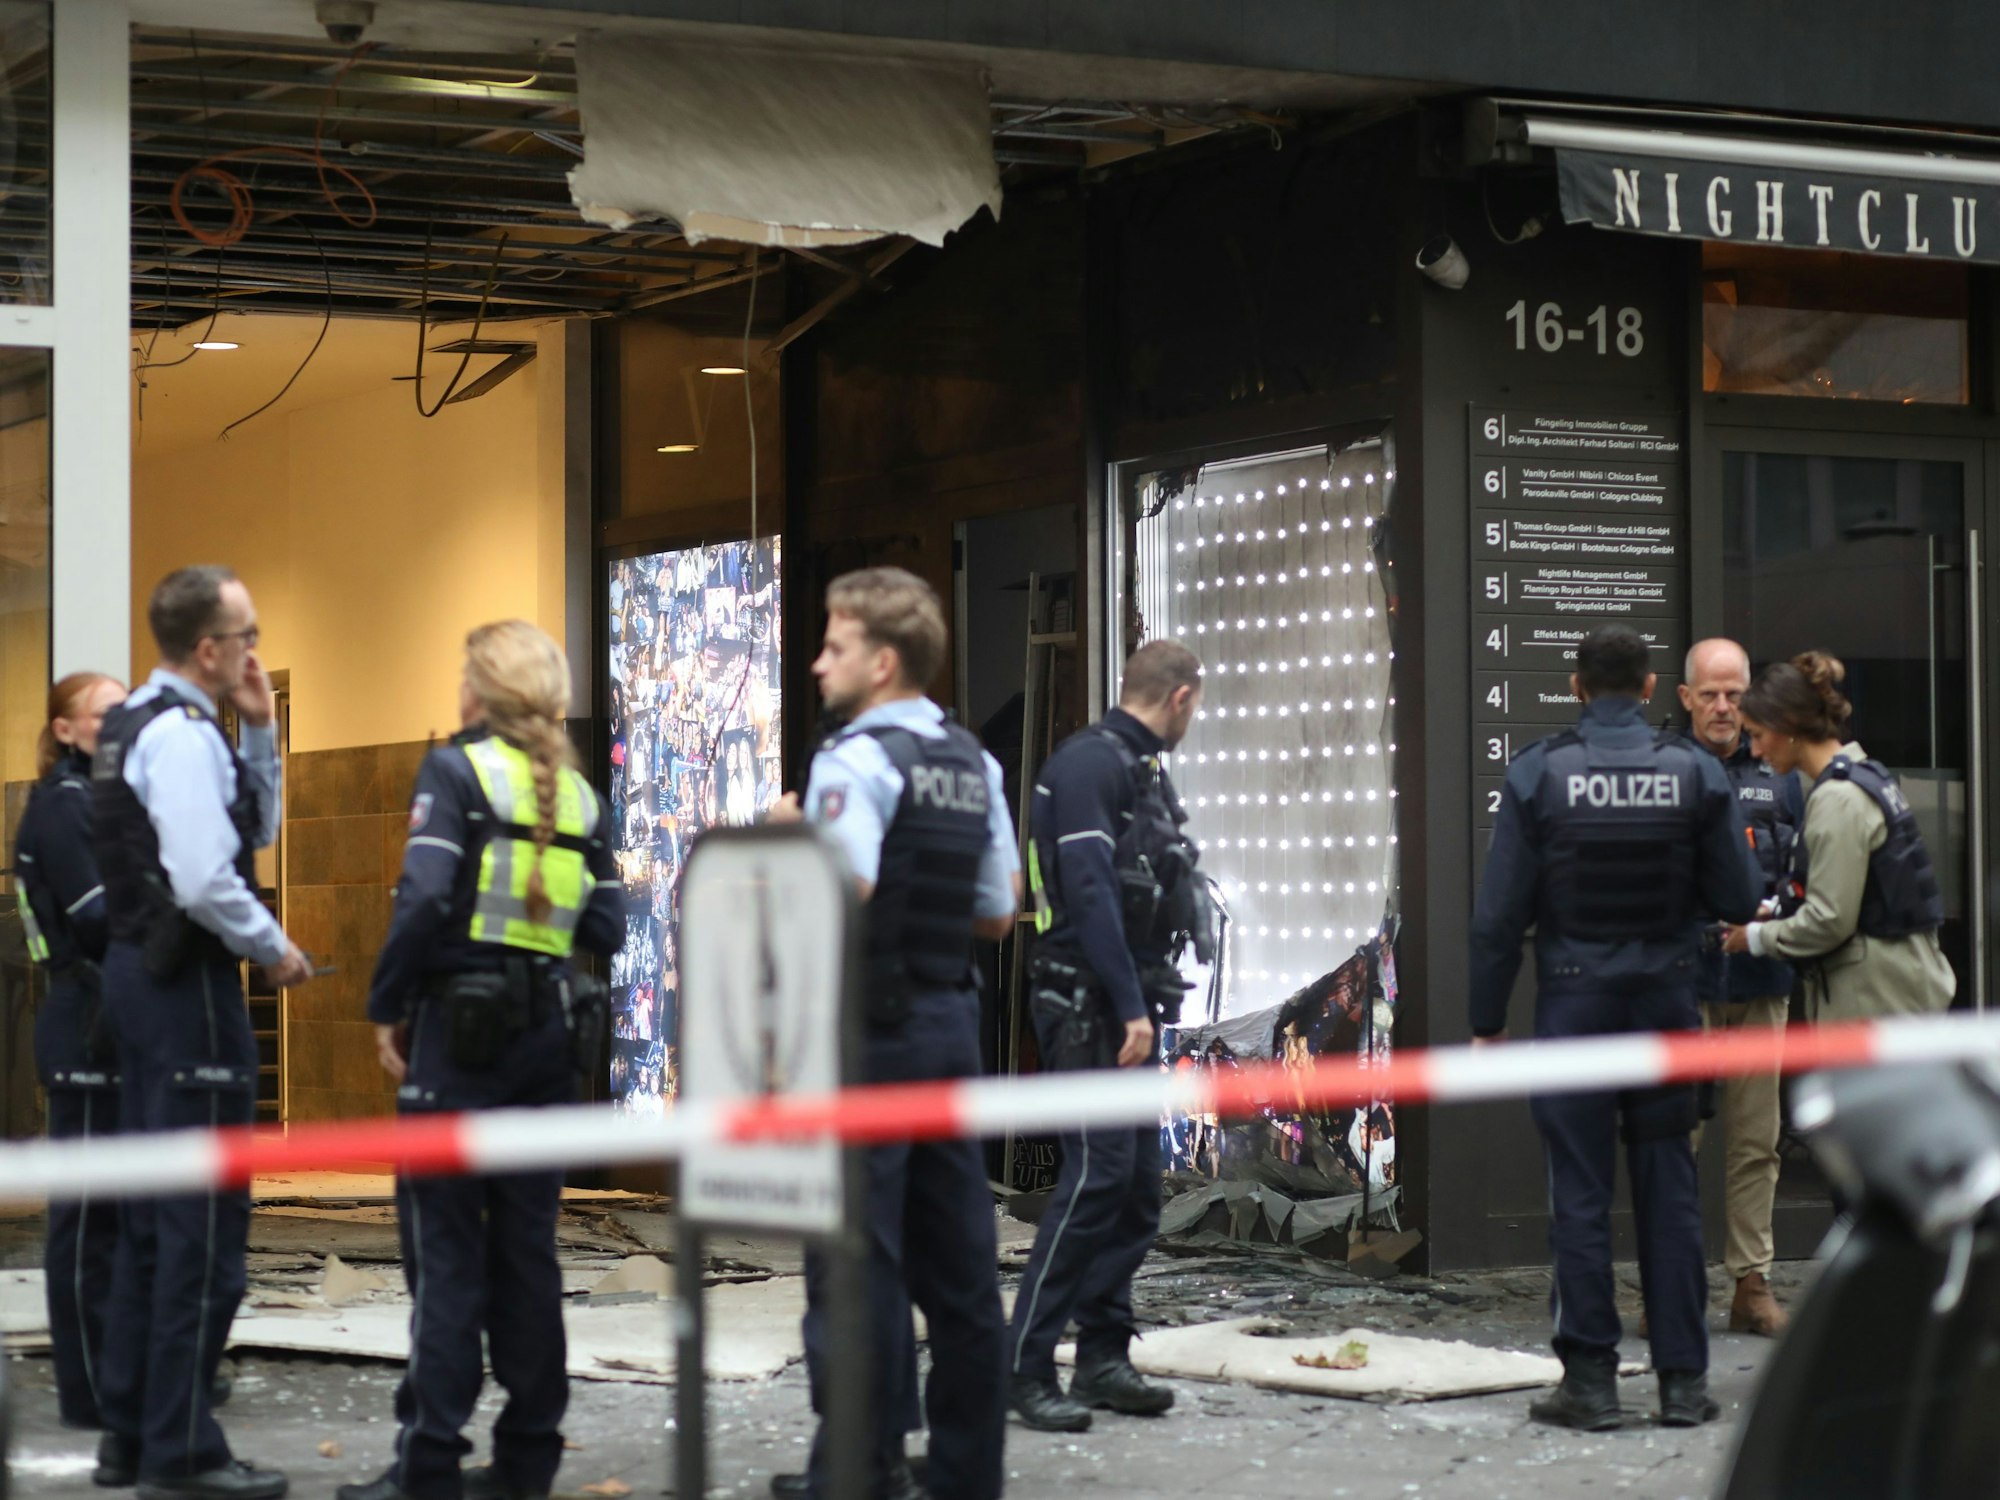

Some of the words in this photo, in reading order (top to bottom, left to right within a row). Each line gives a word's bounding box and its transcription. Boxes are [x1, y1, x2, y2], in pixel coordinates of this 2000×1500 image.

[1612, 168, 1976, 257] NIGHTCLU
[1505, 300, 1644, 357] 16-18
[1484, 418, 1499, 440] 6
[1535, 418, 1573, 429] Füngeling
[1575, 420, 1617, 430] Immobilien
[1619, 422, 1648, 432] Gruppe
[1543, 437, 1578, 446] Architekt
[1580, 439, 1606, 448] Farhad
[1608, 439, 1635, 448] Soltani
[1640, 441, 1654, 449] RCI
[1656, 442, 1679, 450] GmbH
[1484, 471, 1499, 492] 6
[1523, 469, 1547, 479] Vanity
[1550, 469, 1575, 478] GmbH
[1608, 472, 1634, 481] Chicos
[1636, 473, 1658, 482] Event
[1523, 488, 1569, 499] Parookaville
[1570, 490, 1594, 499] GmbH
[1600, 492, 1630, 502] Cologne
[1631, 493, 1663, 504] Clubbing
[1486, 523, 1500, 545] 5
[1514, 522, 1543, 531] Thomas
[1544, 523, 1567, 533] Group
[1568, 524, 1591, 533] GmbH
[1597, 525, 1627, 535] Spencer
[1627, 526, 1632, 534] &
[1634, 526, 1645, 534] Hill
[1647, 527, 1669, 535] GmbH
[1510, 541, 1529, 549] Book
[1530, 542, 1550, 551] Kings
[1551, 542, 1575, 550] GmbH
[1581, 544, 1619, 552] Bootshaus
[1620, 545, 1649, 555] Cologne
[1650, 546, 1674, 554] GmbH
[1538, 569, 1571, 579] Nightlife
[1573, 570, 1621, 580] Management
[1623, 572, 1647, 580] GmbH
[1486, 577, 1500, 599] 5
[1524, 585, 1559, 595] Flamingo
[1561, 586, 1582, 595] Royal
[1583, 586, 1607, 594] GmbH
[1638, 588, 1662, 596] GmbH
[1555, 601, 1605, 612] Springinsfeld
[1606, 603, 1631, 611] GmbH
[1486, 629, 1501, 650] 4
[1534, 630, 1558, 639] Effekt
[1560, 631, 1584, 640] Media
[1487, 686, 1501, 707] 4
[1538, 694, 1582, 703] Tradewin
[1488, 738, 1502, 759] 3
[1567, 774, 1680, 807] POLIZEI
[1739, 787, 1773, 801] POLIZEI
[1488, 791, 1502, 812] 2
[1014, 1165, 1045, 1190] UT
